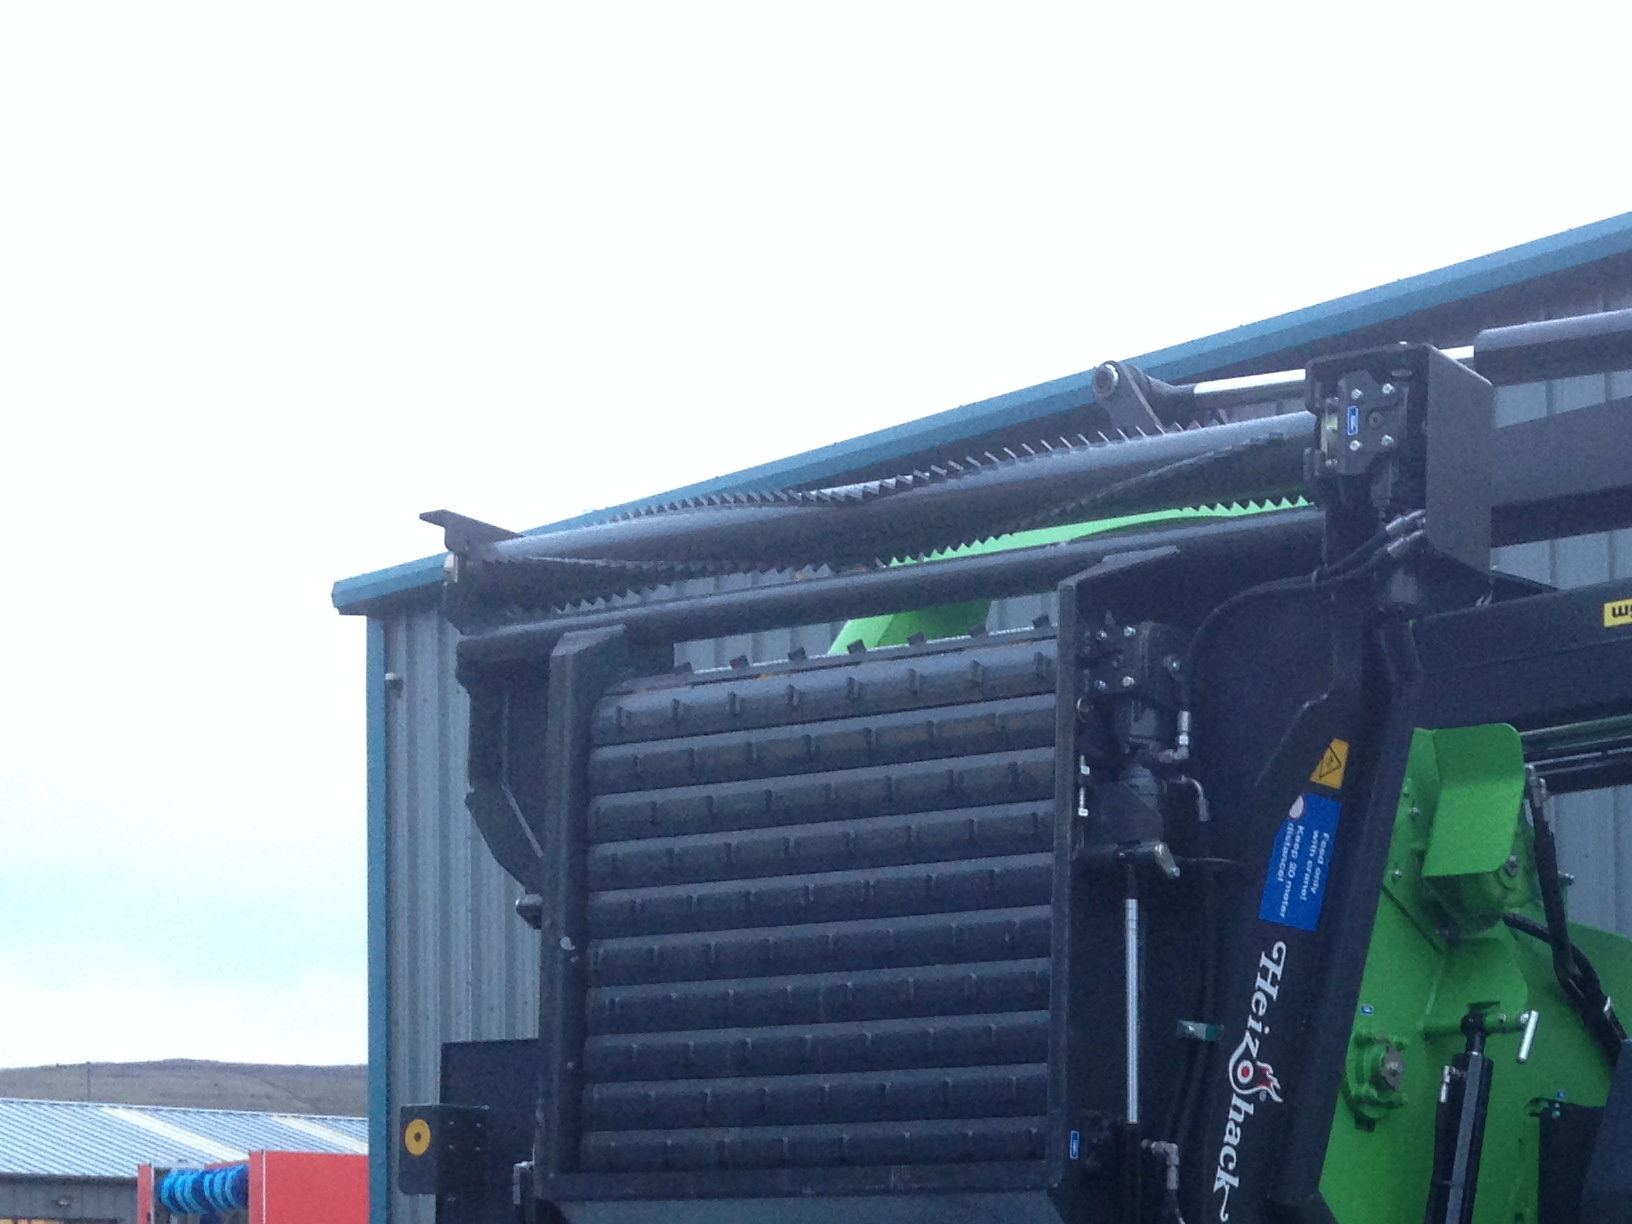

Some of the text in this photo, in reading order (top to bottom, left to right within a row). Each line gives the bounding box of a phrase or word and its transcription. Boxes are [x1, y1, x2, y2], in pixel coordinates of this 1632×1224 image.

[1291, 824, 1305, 859] Keep
[1309, 829, 1319, 857] with
[1310, 832, 1330, 895] Feed only
[1280, 880, 1292, 918] meter
